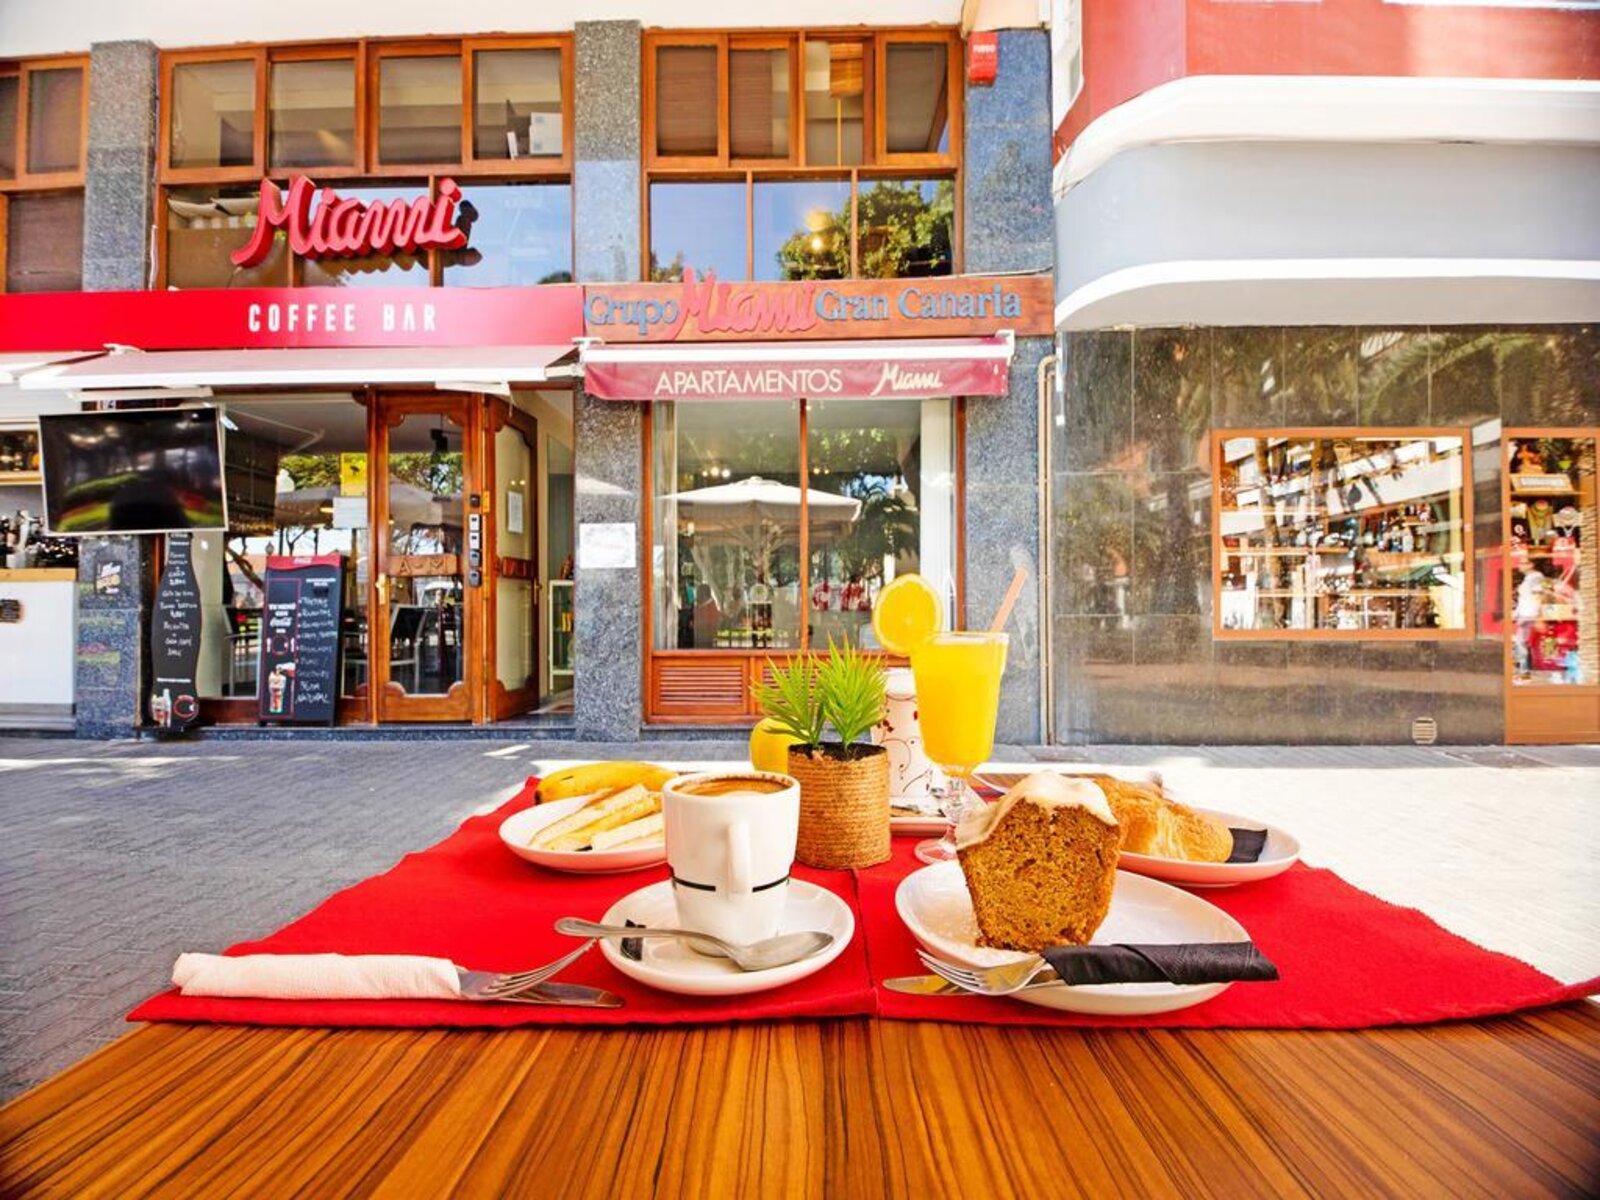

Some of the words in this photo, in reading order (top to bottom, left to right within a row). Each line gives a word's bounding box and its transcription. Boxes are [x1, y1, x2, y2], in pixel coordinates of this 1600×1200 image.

[231, 174, 467, 269] Miami
[249, 304, 355, 332] COFFEE
[382, 304, 436, 331] BAR
[583, 293, 679, 336] Grupo
[664, 266, 818, 341] Miami
[815, 288, 889, 322] Gran
[897, 282, 1023, 321] Canaria
[654, 368, 843, 395] APARTAMENTOS
[870, 363, 943, 397] Miami
